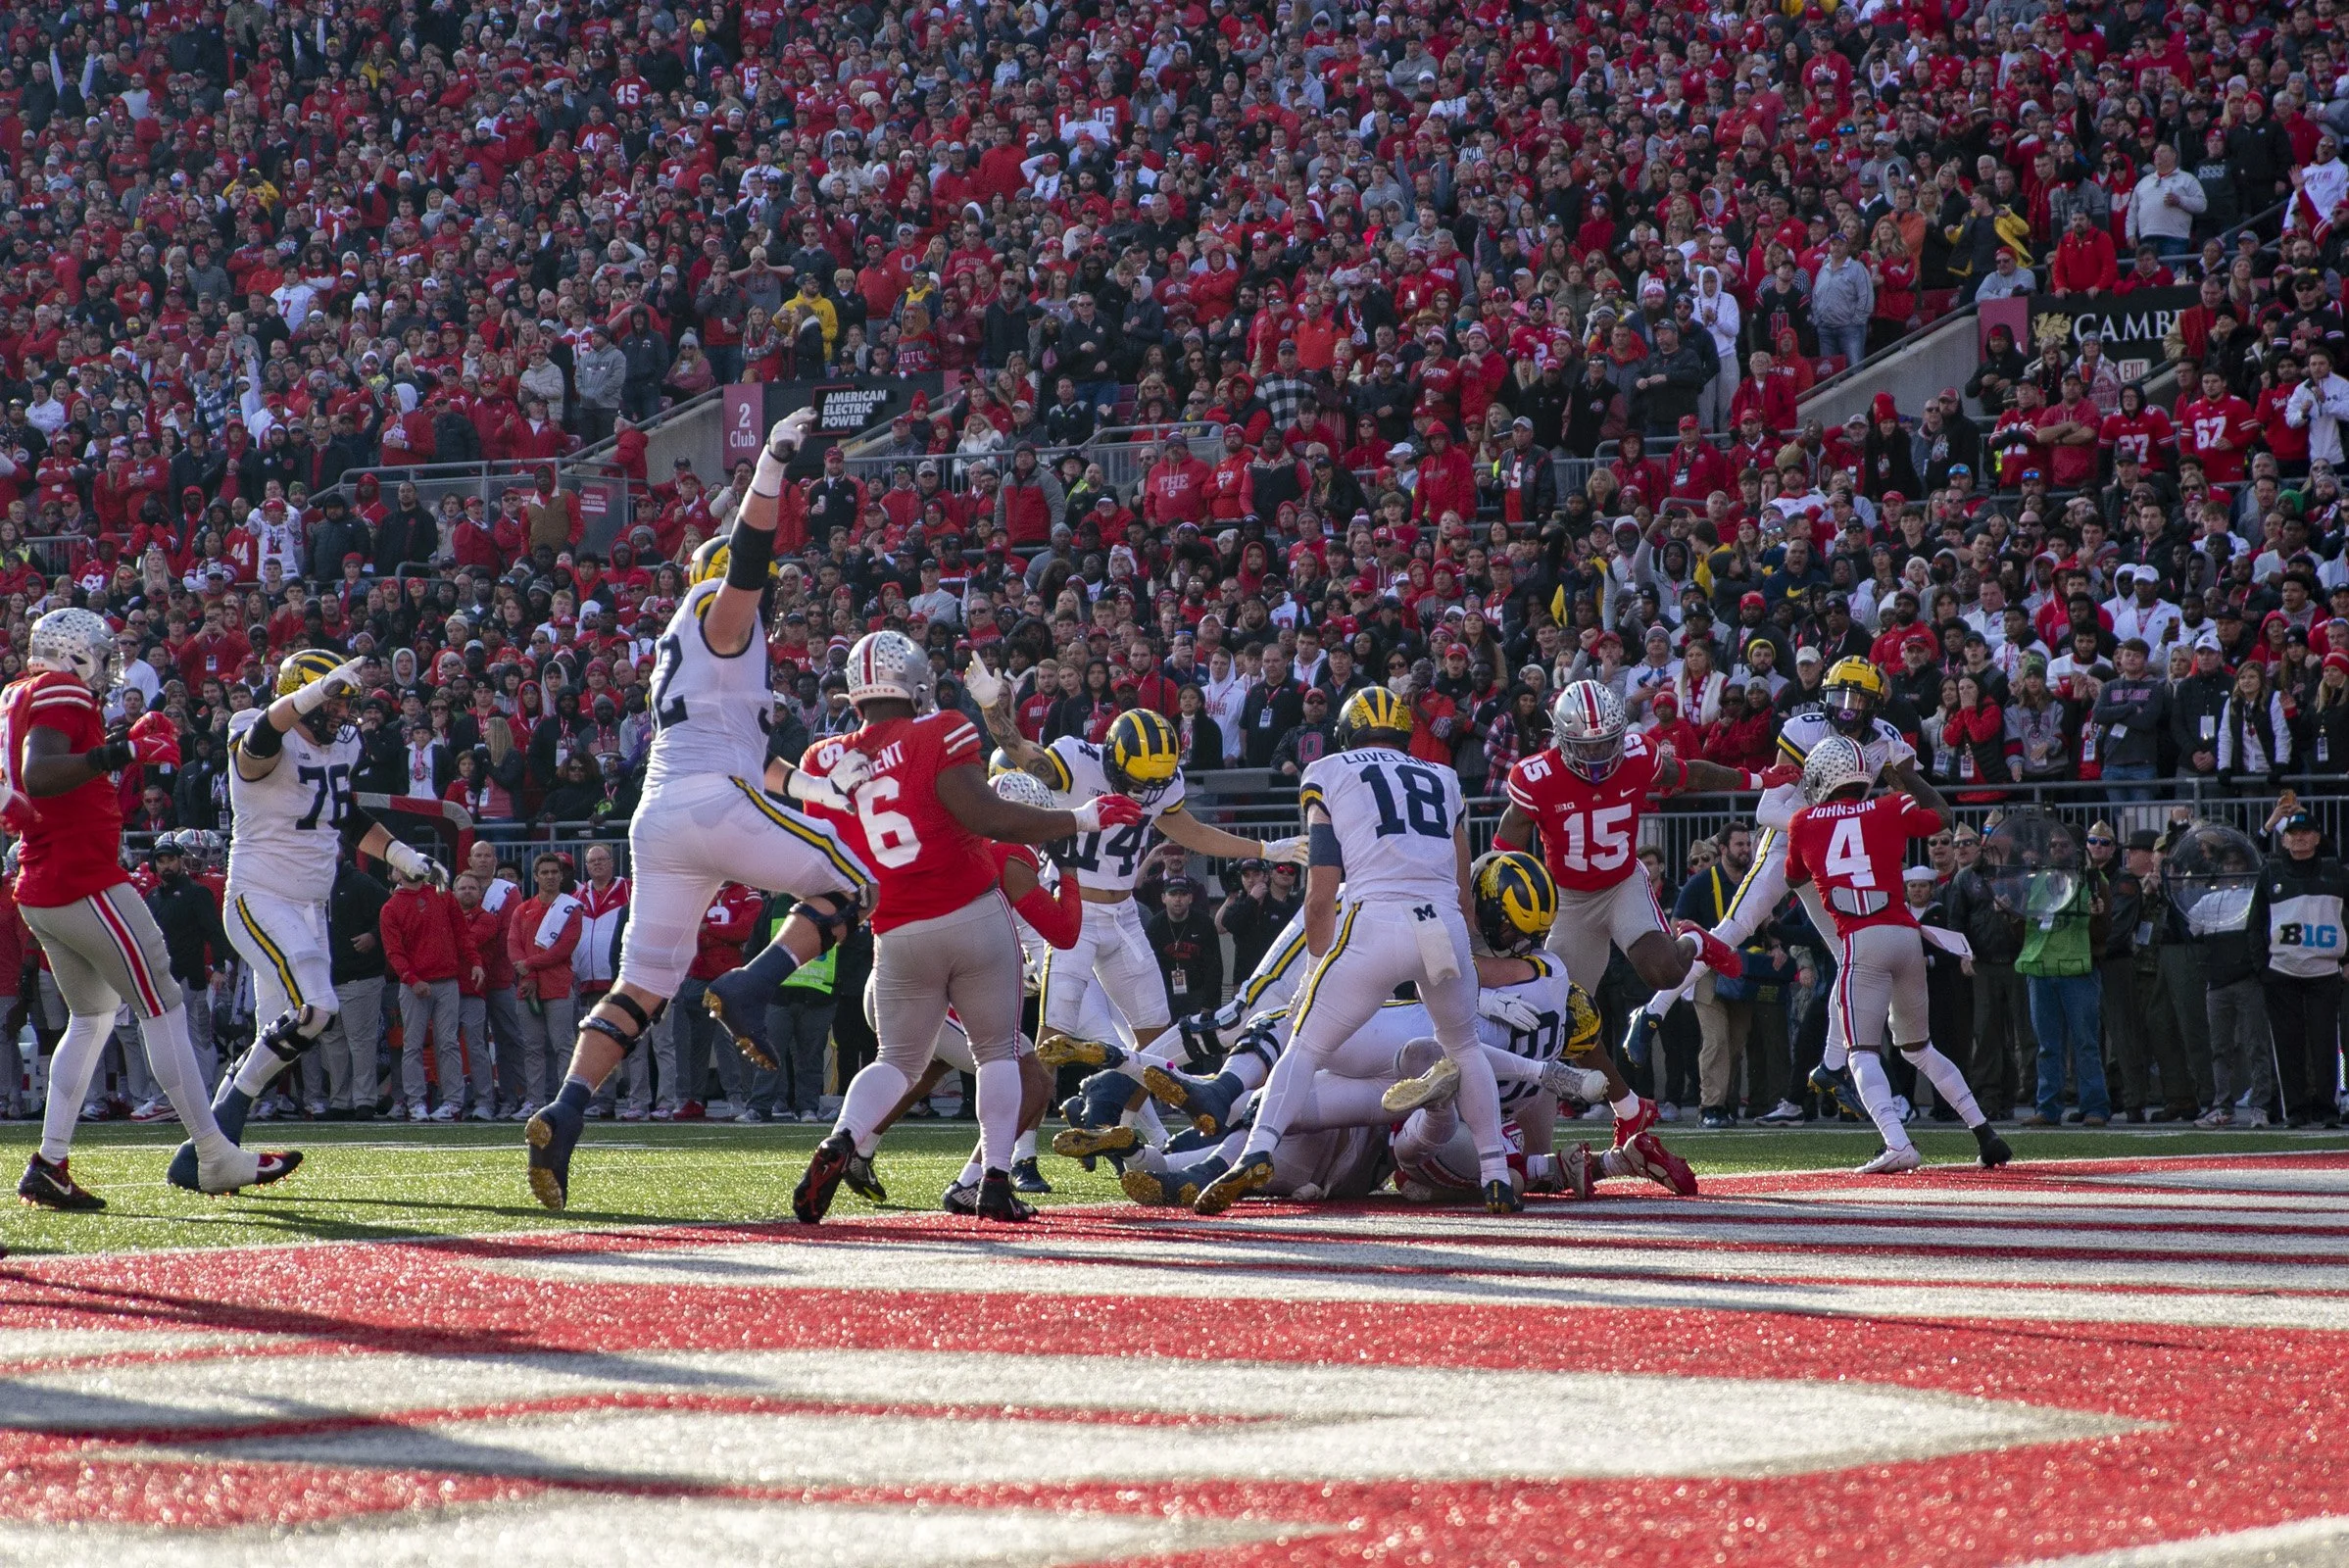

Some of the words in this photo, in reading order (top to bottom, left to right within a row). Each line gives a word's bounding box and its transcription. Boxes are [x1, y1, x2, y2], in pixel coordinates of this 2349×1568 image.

[616, 84, 640, 104] 45
[1094, 106, 1115, 126] 16
[2123, 362, 2144, 380] EXIT
[825, 390, 886, 404] AMERICAN
[738, 403, 751, 428] 2
[823, 402, 872, 416] ELECTRIC
[821, 415, 863, 428] POWER
[729, 429, 756, 448] Club
[2194, 416, 2227, 450] 67
[1158, 473, 1189, 492] THE
[1342, 752, 1439, 770] LOVELAND
[296, 762, 352, 830] 76
[1359, 763, 1452, 840] 18
[1806, 799, 1876, 820] JOHNSON
[855, 775, 922, 869] 6
[1076, 813, 1152, 877] 14
[1563, 802, 1633, 872] 15
[1825, 816, 1877, 888] 4
[1412, 904, 1438, 922] M
